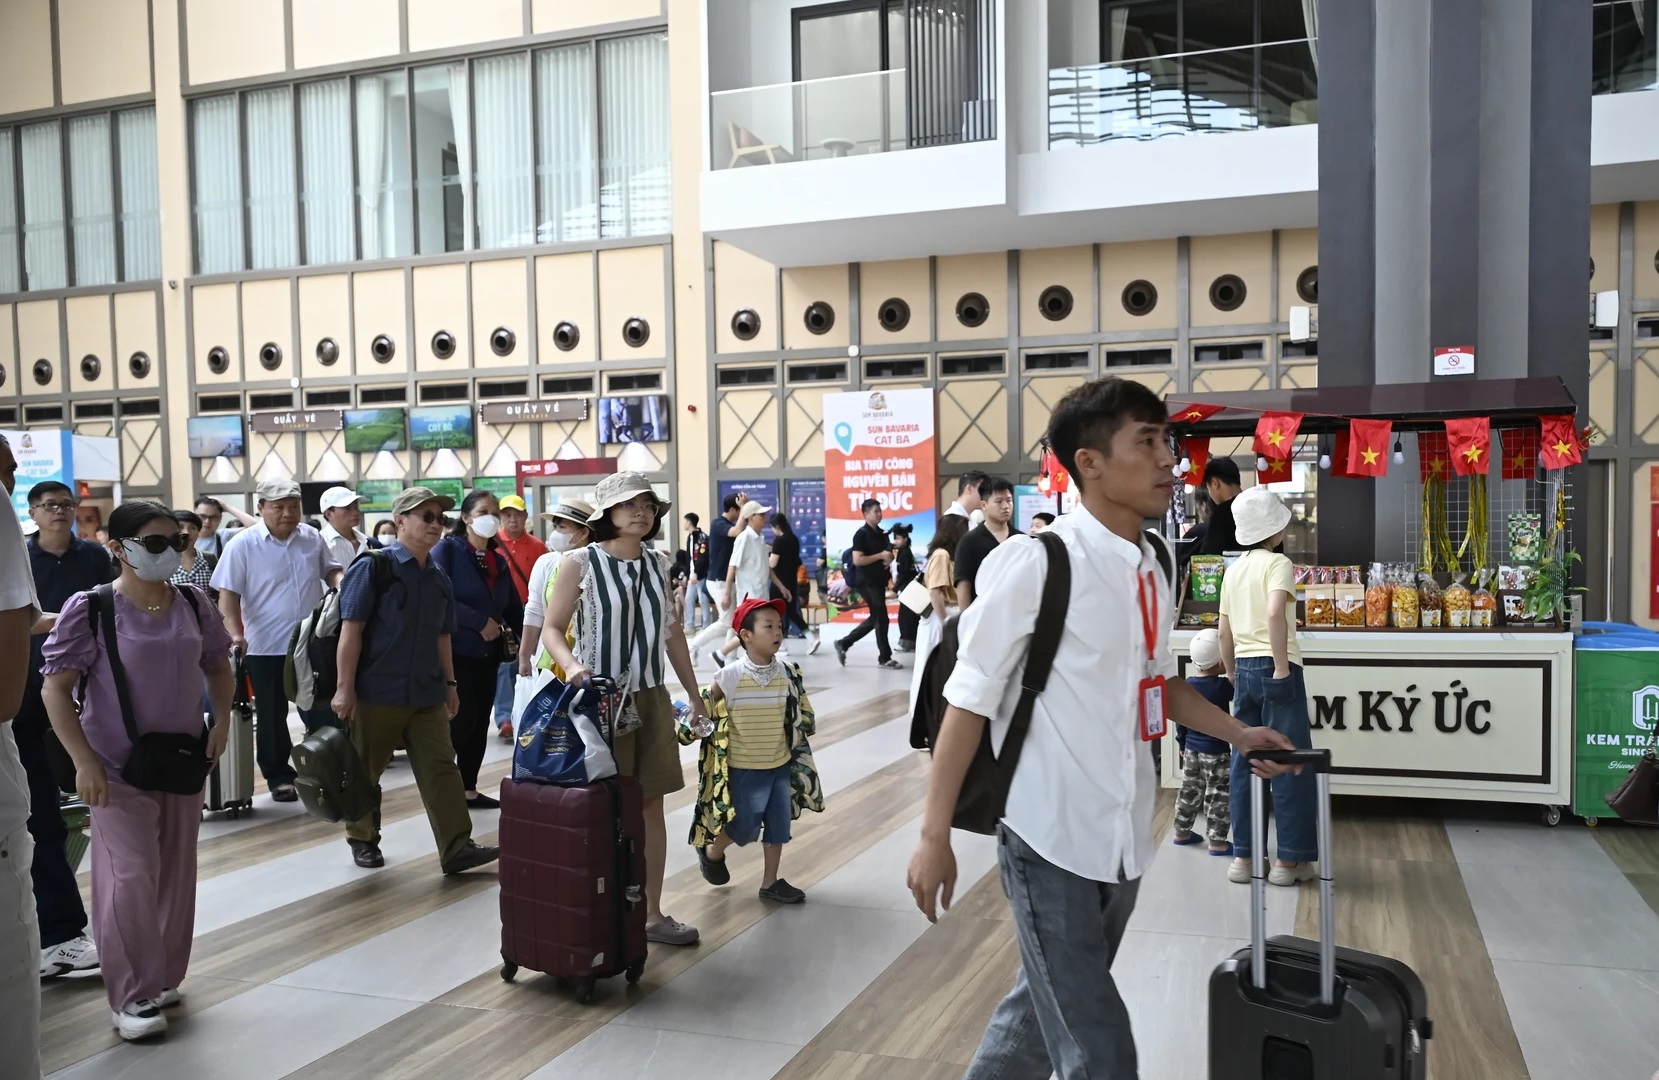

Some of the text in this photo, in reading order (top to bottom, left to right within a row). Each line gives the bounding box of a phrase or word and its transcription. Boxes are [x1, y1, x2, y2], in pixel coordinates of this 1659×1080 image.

[867, 424, 920, 434] SUN BAVARIA
[874, 435, 910, 445] CAT BA
[844, 460, 862, 471] BIA
[885, 456, 914, 470] CÔNG
[843, 472, 889, 488] NGUYÊN
[1310, 679, 1491, 734] M KÝ ỨC
[1586, 734, 1620, 746] KEM
